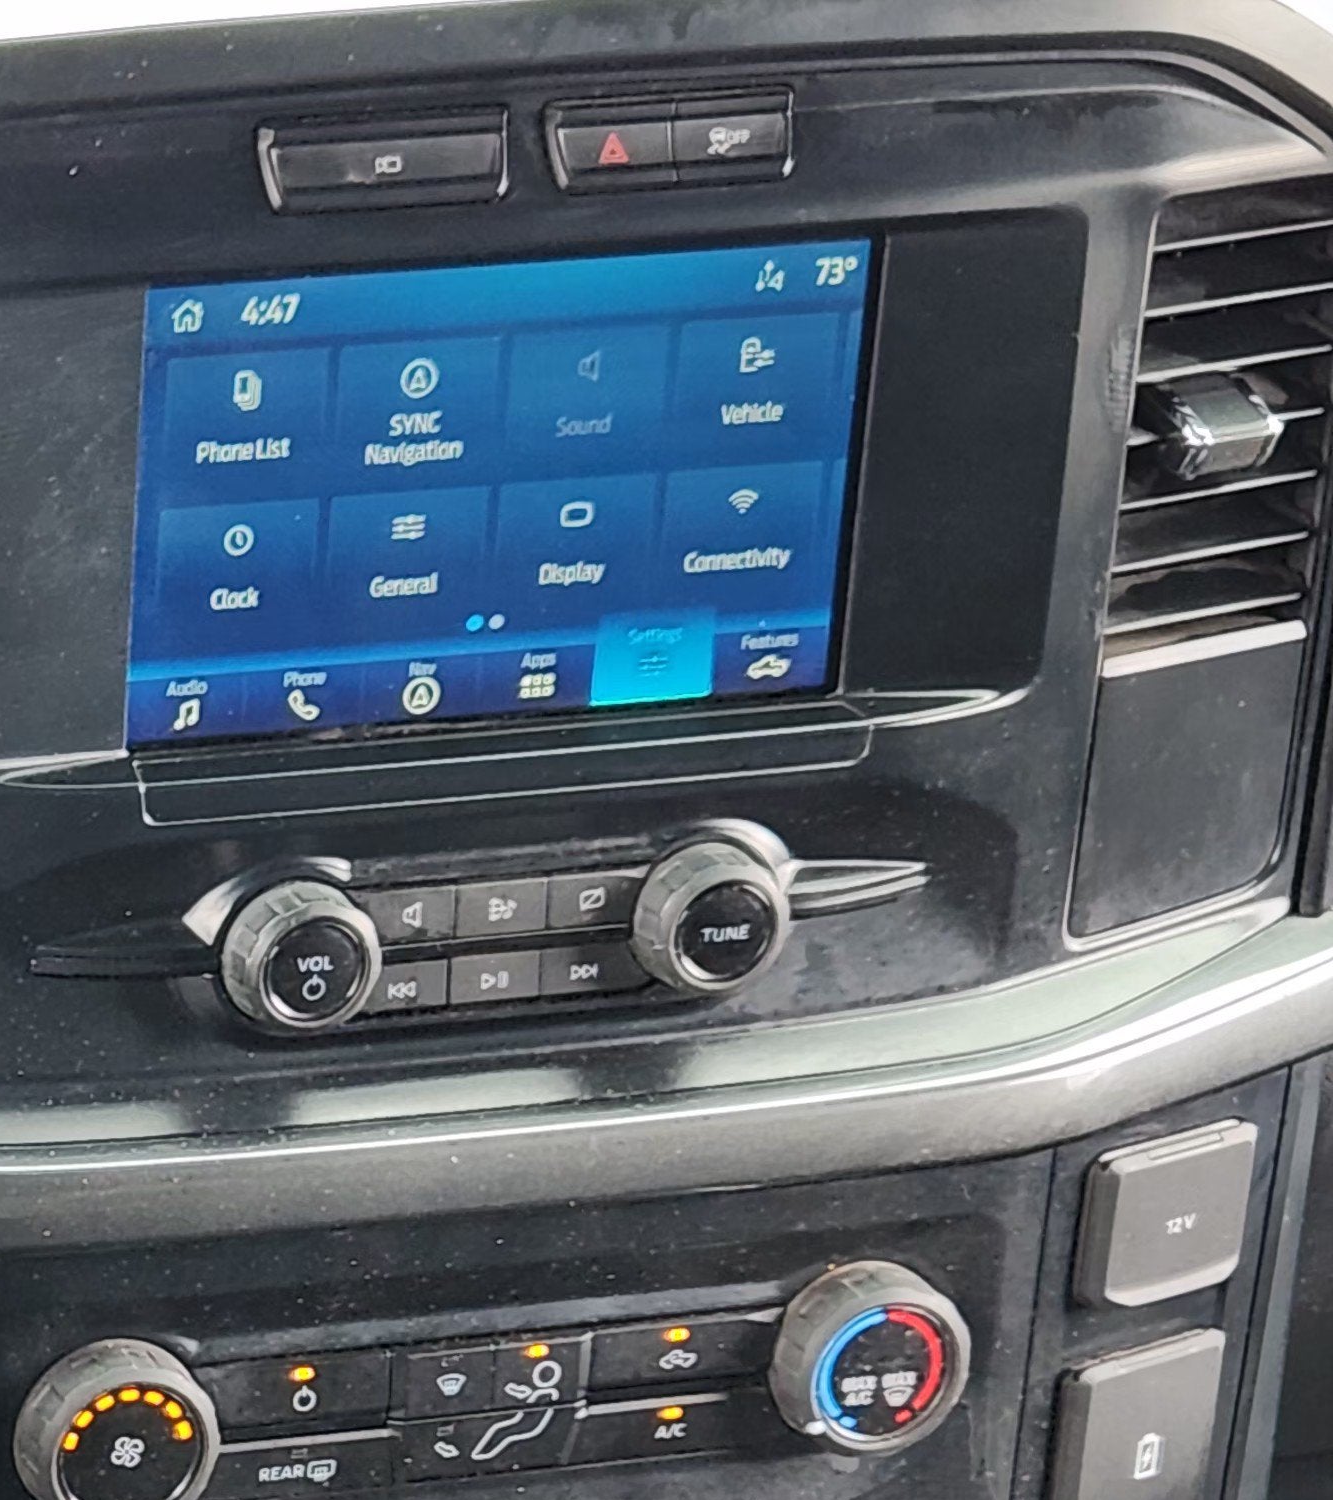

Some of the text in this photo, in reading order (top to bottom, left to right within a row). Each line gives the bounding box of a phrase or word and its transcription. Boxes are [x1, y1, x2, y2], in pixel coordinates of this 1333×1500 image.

[815, 255, 858, 287] 73°
[241, 293, 301, 325] 4:47
[389, 410, 443, 436] SYNC
[555, 413, 613, 438] Sound
[720, 400, 784, 426] Vehicle
[195, 437, 291, 464] Phone List
[363, 440, 464, 467] Navigation
[683, 547, 792, 573] Connectivity
[369, 572, 438, 598] General
[538, 560, 605, 587] Display
[209, 586, 259, 611] Clock
[741, 633, 799, 650] Features
[520, 652, 557, 670] Apps
[165, 680, 208, 697] Audio
[283, 671, 327, 688] Phone
[700, 923, 751, 942] TUNE
[297, 955, 334, 973] VOL
[654, 1421, 688, 1440] A/C
[258, 1464, 305, 1483] REAR
